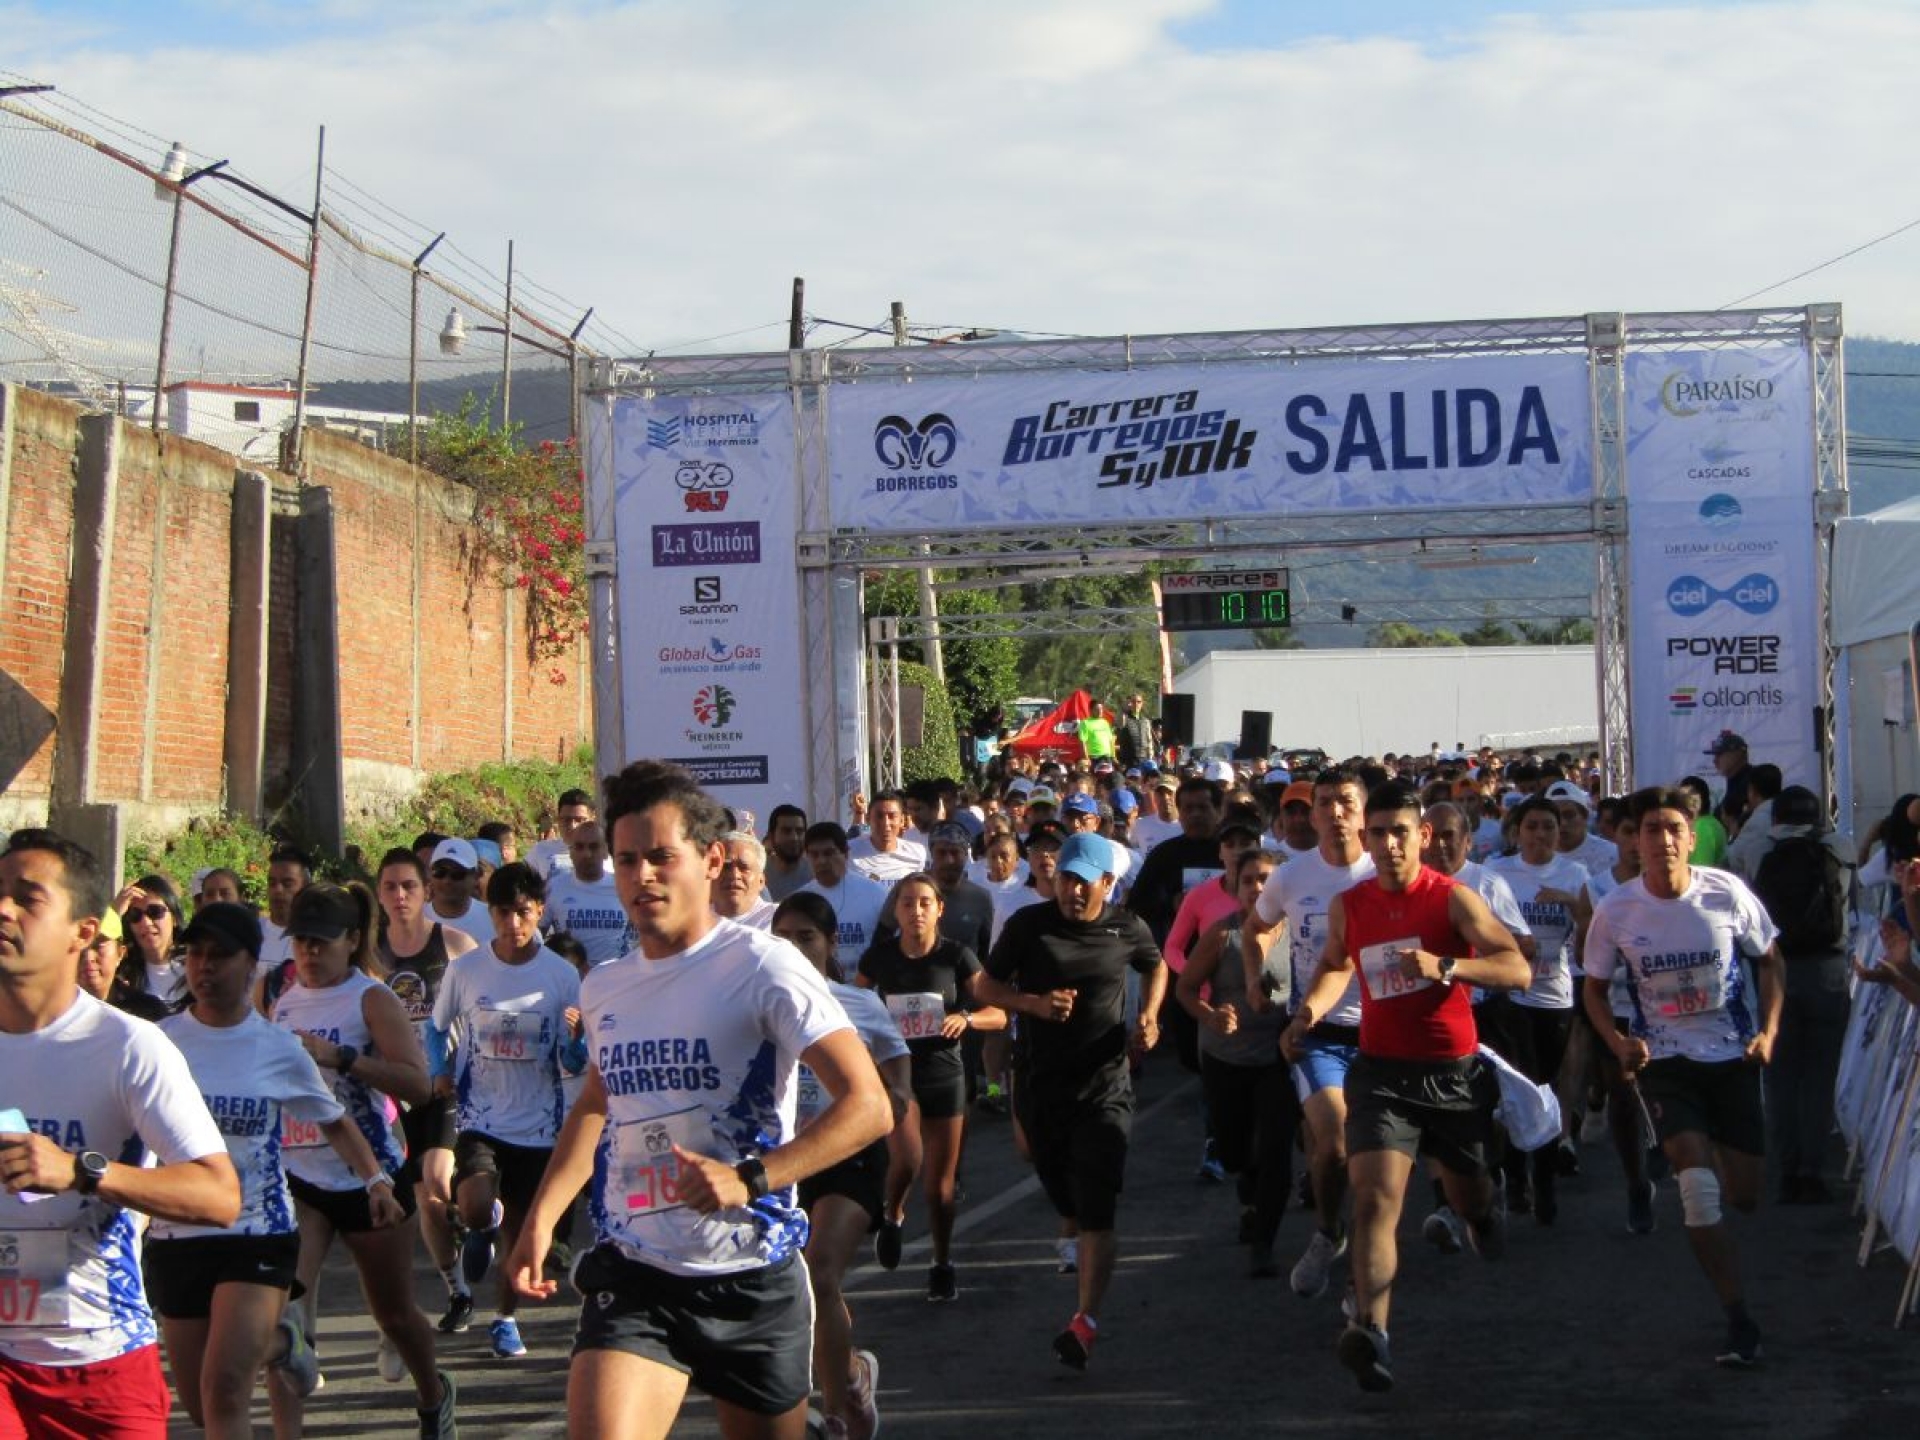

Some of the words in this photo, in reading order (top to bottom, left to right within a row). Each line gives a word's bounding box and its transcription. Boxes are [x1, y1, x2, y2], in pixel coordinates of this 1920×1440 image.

[1676, 373, 1774, 402] PARAÍSO
[684, 413, 758, 427] HOSPITAL
[1043, 389, 1199, 432] Carrera
[1002, 409, 1227, 466] Borregos
[1285, 386, 1561, 475] SALIDA
[1688, 466, 1750, 479] CASCADAS
[876, 474, 958, 493] BORREGOS
[658, 531, 686, 555] La
[692, 528, 754, 553] Unión
[1670, 586, 1707, 605] ciel
[1735, 583, 1772, 603] ciel
[659, 647, 705, 662] Global
[735, 645, 761, 659] Gas
[1667, 635, 1780, 656] POWER
[1714, 655, 1778, 675] ADE
[1702, 683, 1783, 708] atlantis
[689, 732, 742, 742] HEINEKEN
[568, 909, 624, 919] CARRERA
[600, 1038, 711, 1071] CARRERA
[602, 1066, 720, 1097] ORREGOS
